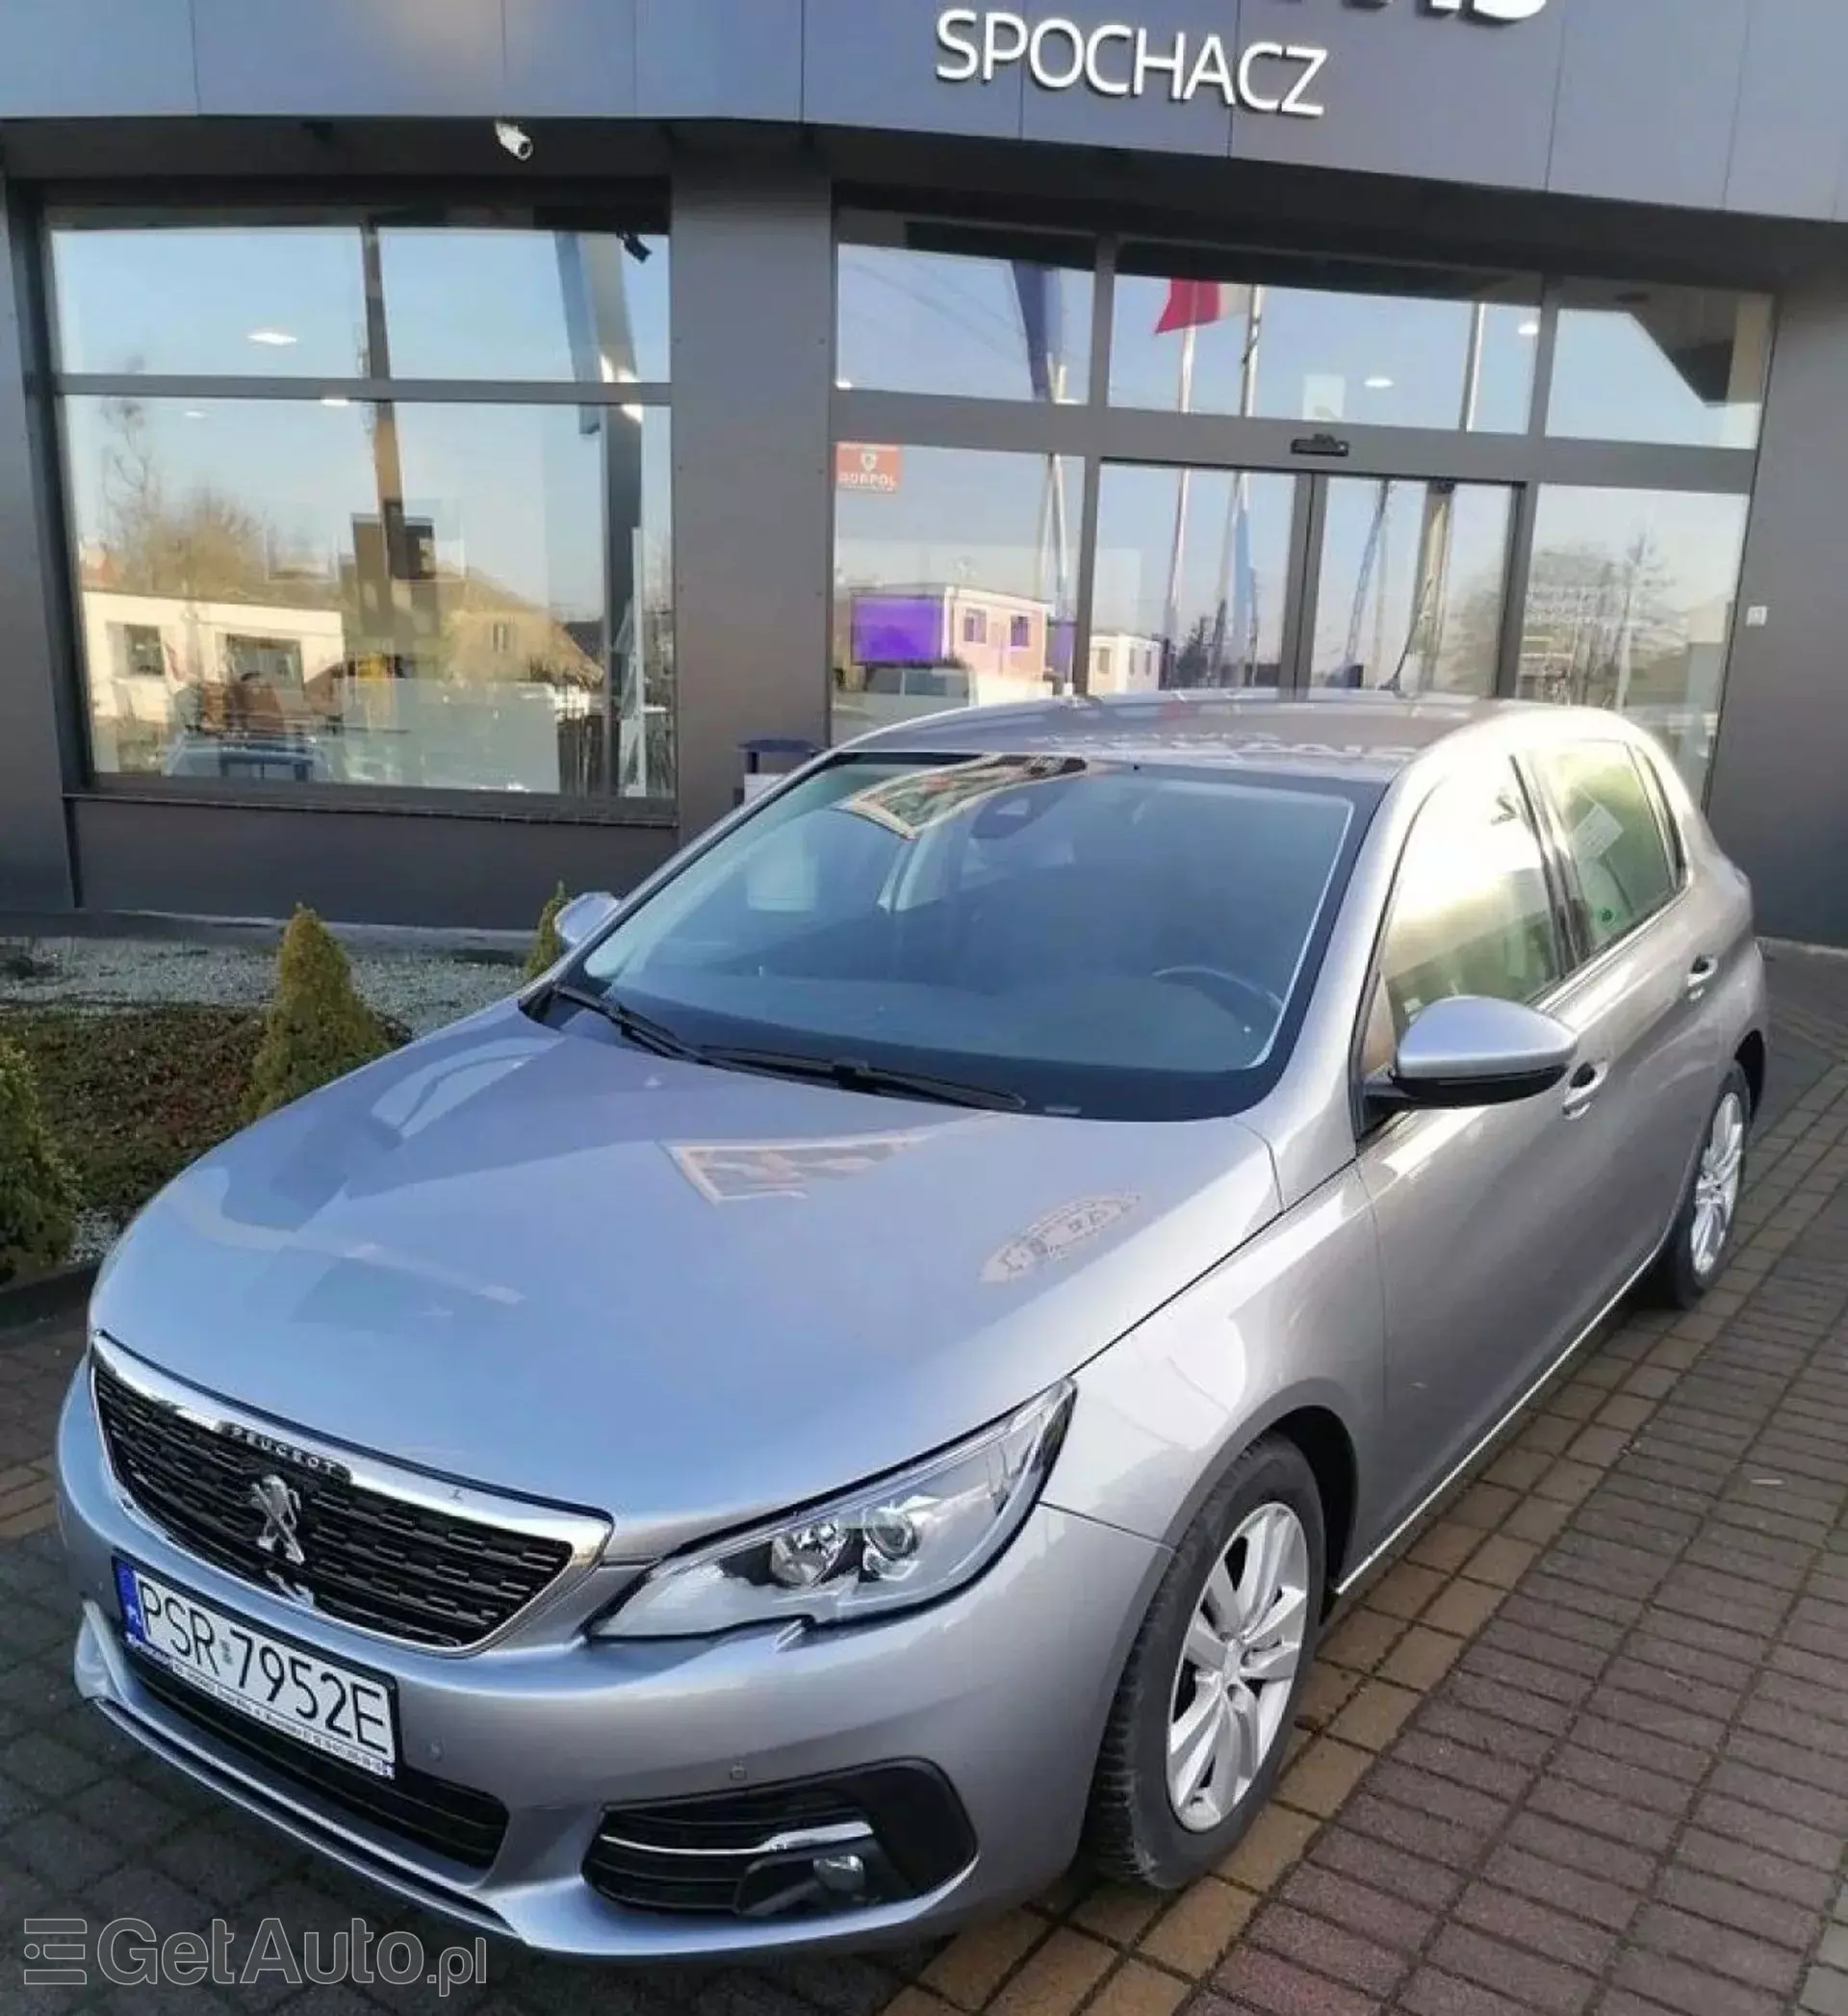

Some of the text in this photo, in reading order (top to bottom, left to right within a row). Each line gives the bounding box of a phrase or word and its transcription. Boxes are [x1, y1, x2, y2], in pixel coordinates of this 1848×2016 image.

[936, 9, 1327, 116] SPOCHACZ
[138, 1580, 220, 1676] PSR
[229, 1628, 388, 1754] 7952E
